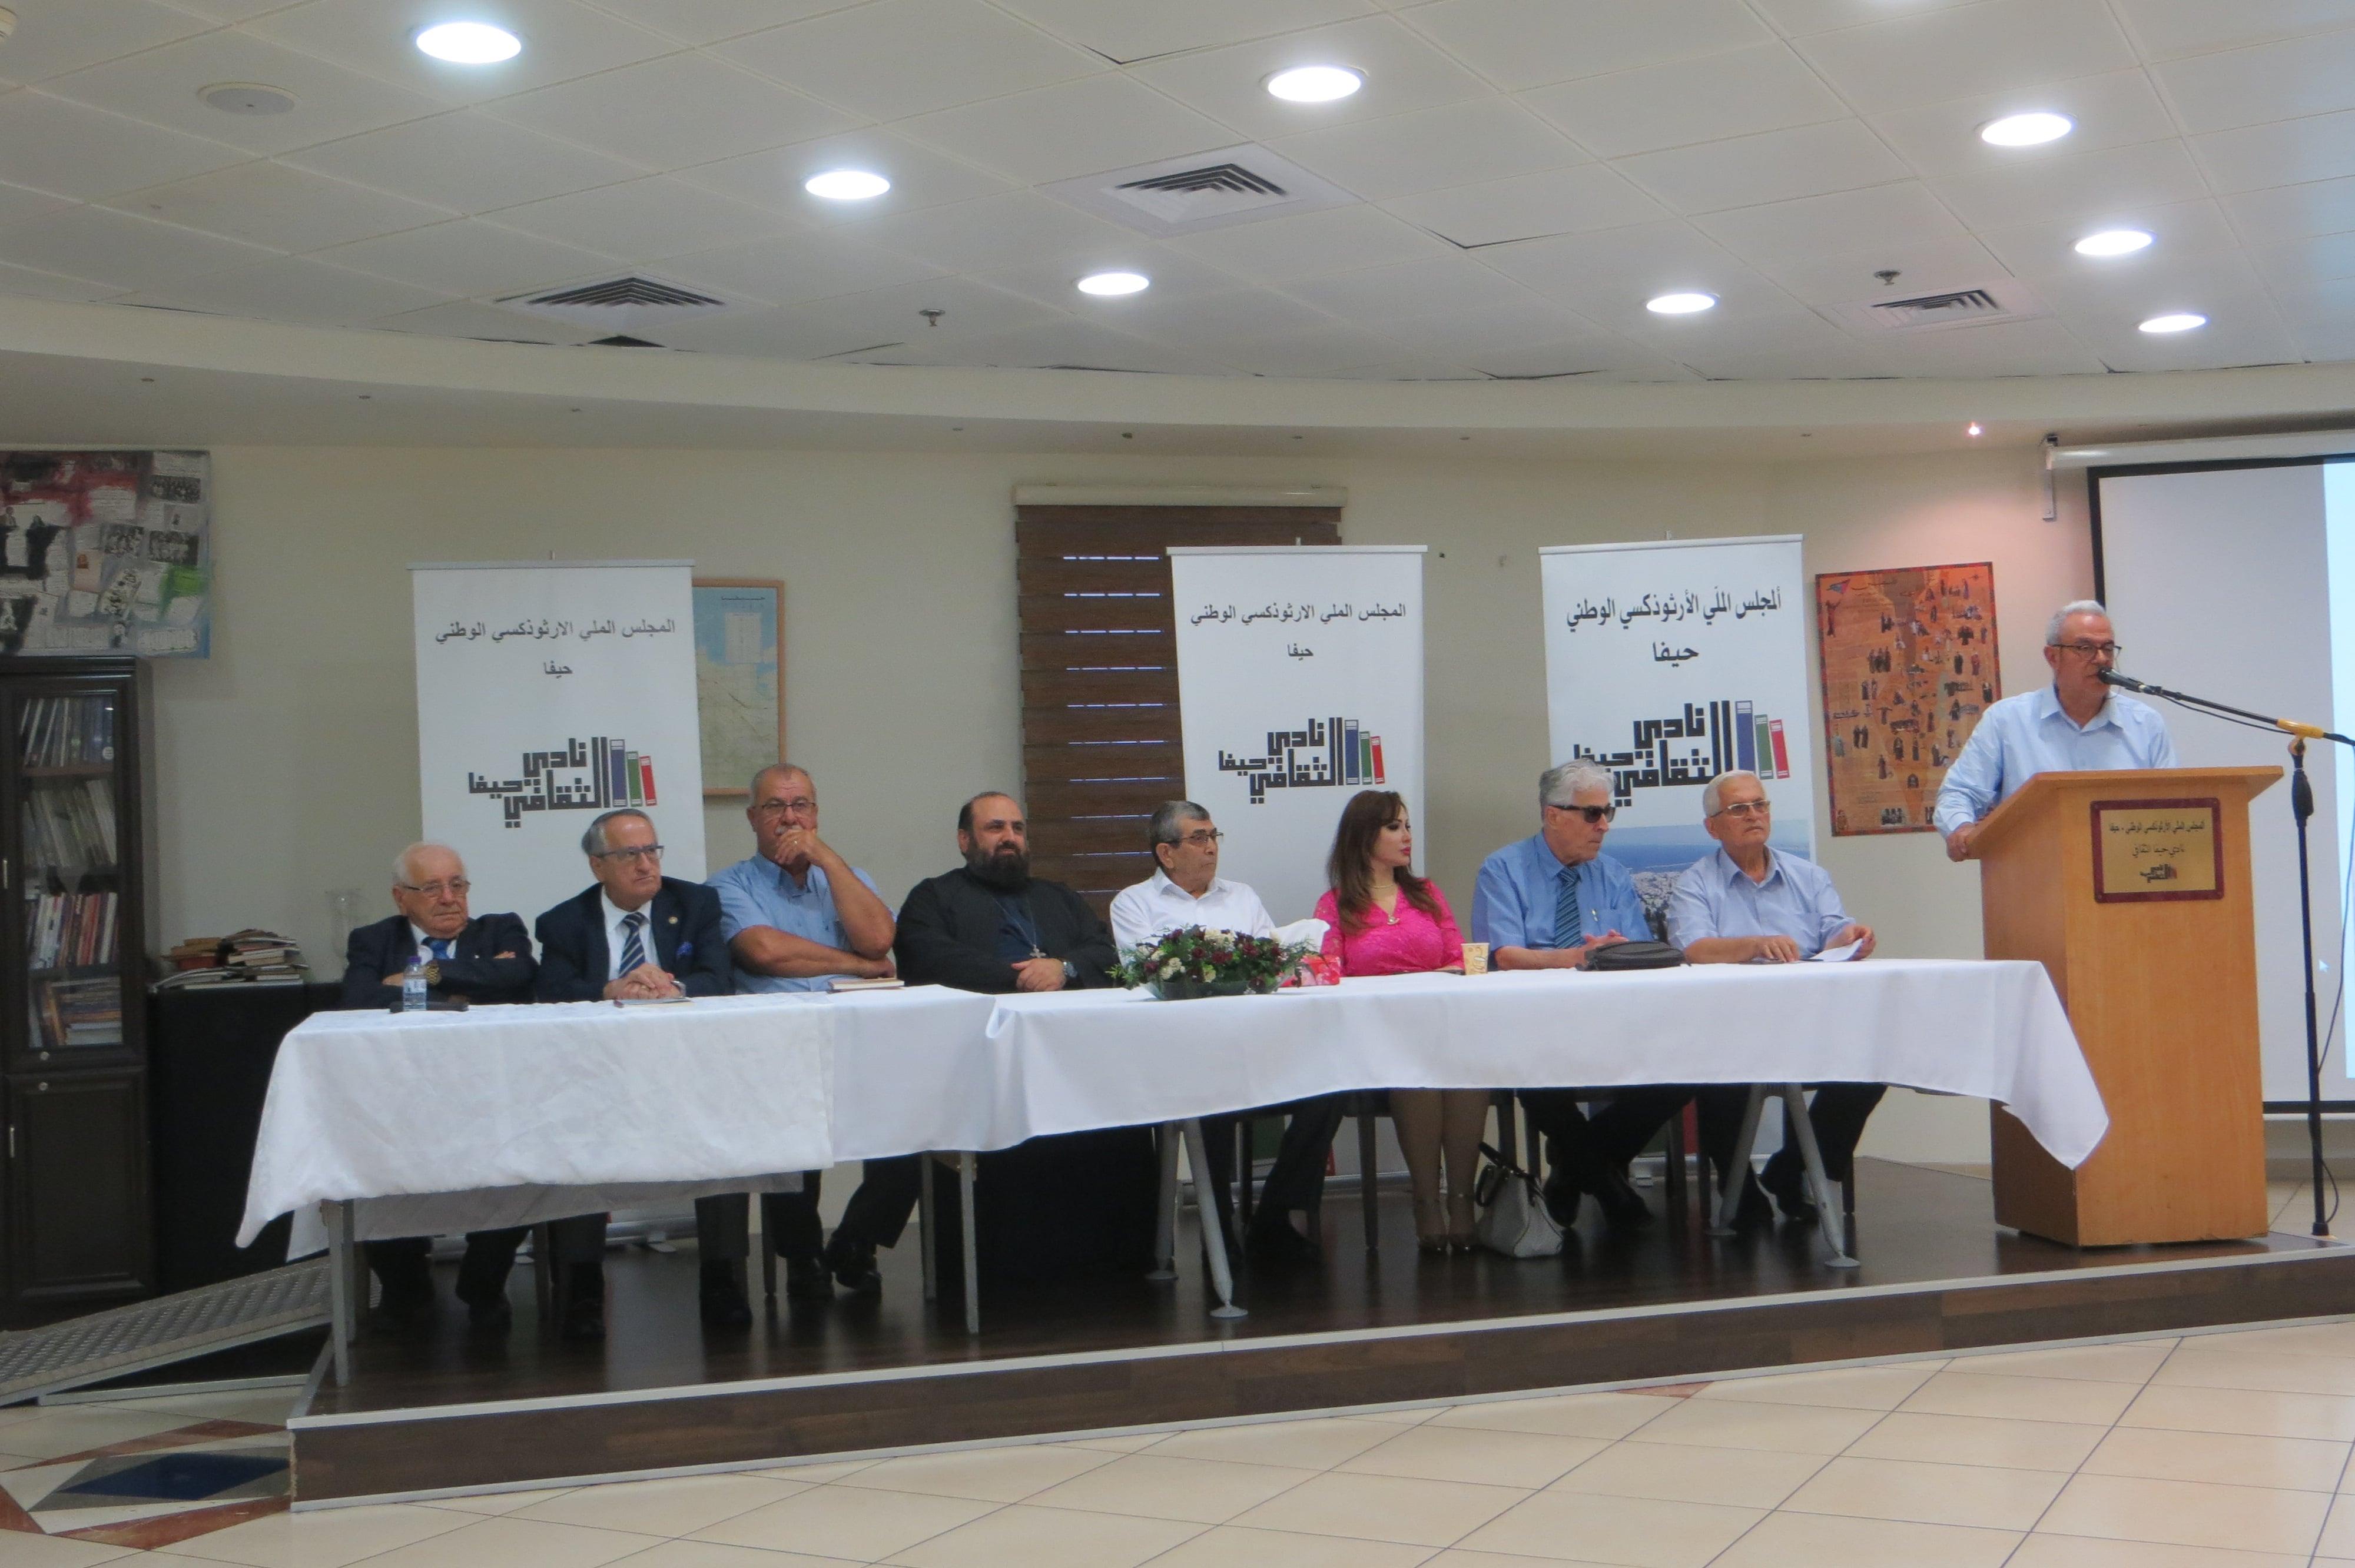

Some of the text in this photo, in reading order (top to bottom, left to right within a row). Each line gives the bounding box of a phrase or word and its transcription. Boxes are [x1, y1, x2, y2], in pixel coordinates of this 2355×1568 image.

[1190, 602, 1406, 626] المجلس الملي الارثوذكسي الوطني
[1567, 597, 1616, 632] الوطني
[1620, 589, 1699, 629] الأرثوذكسي
[435, 621, 486, 645] الوطني
[579, 620, 615, 642] الملي
[622, 619, 675, 638] المجلس
[1287, 643, 1314, 661] حيفا
[1652, 641, 1700, 668] حيفا
[543, 660, 573, 679] حيفا
[1218, 750, 1267, 776] حيفا
[468, 772, 523, 799] حيفا
